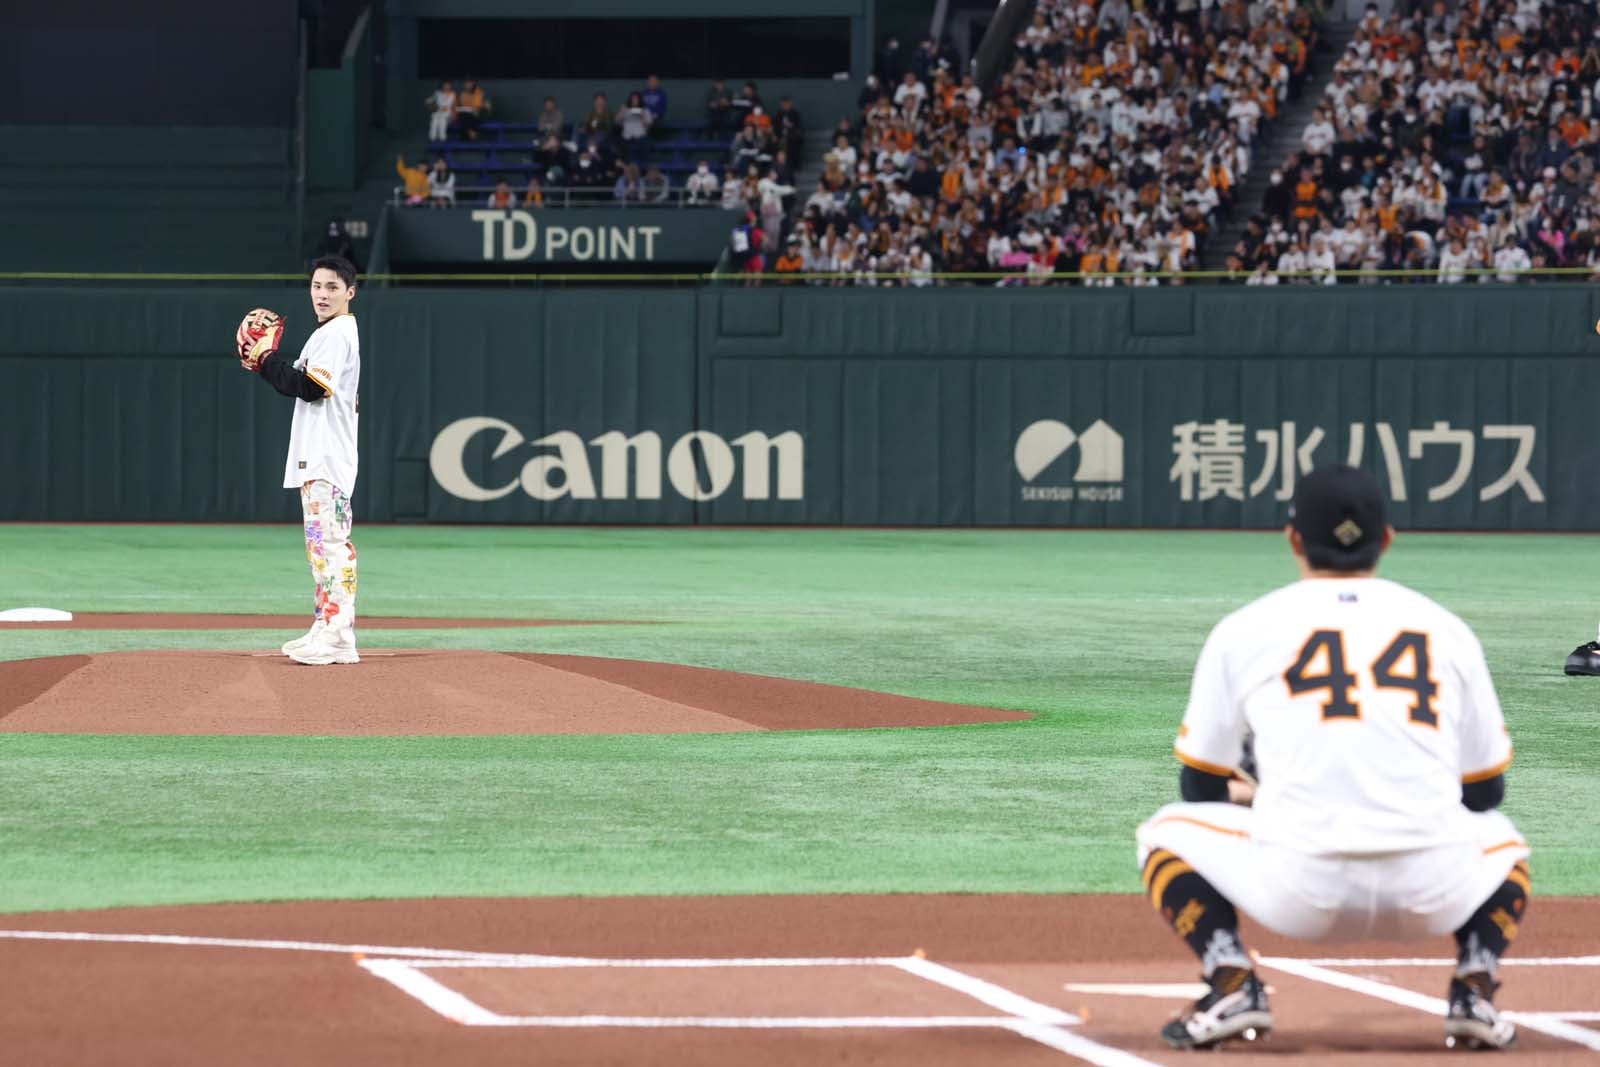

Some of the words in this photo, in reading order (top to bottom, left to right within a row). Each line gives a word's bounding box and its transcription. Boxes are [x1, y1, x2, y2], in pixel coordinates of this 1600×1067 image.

[472, 210, 537, 261] TD
[544, 226, 662, 260] POINT
[429, 416, 804, 502] Canon
[1077, 486, 1123, 501] HOUSE
[1169, 418, 1545, 503] 積水ハウス
[1282, 627, 1441, 732] 44
